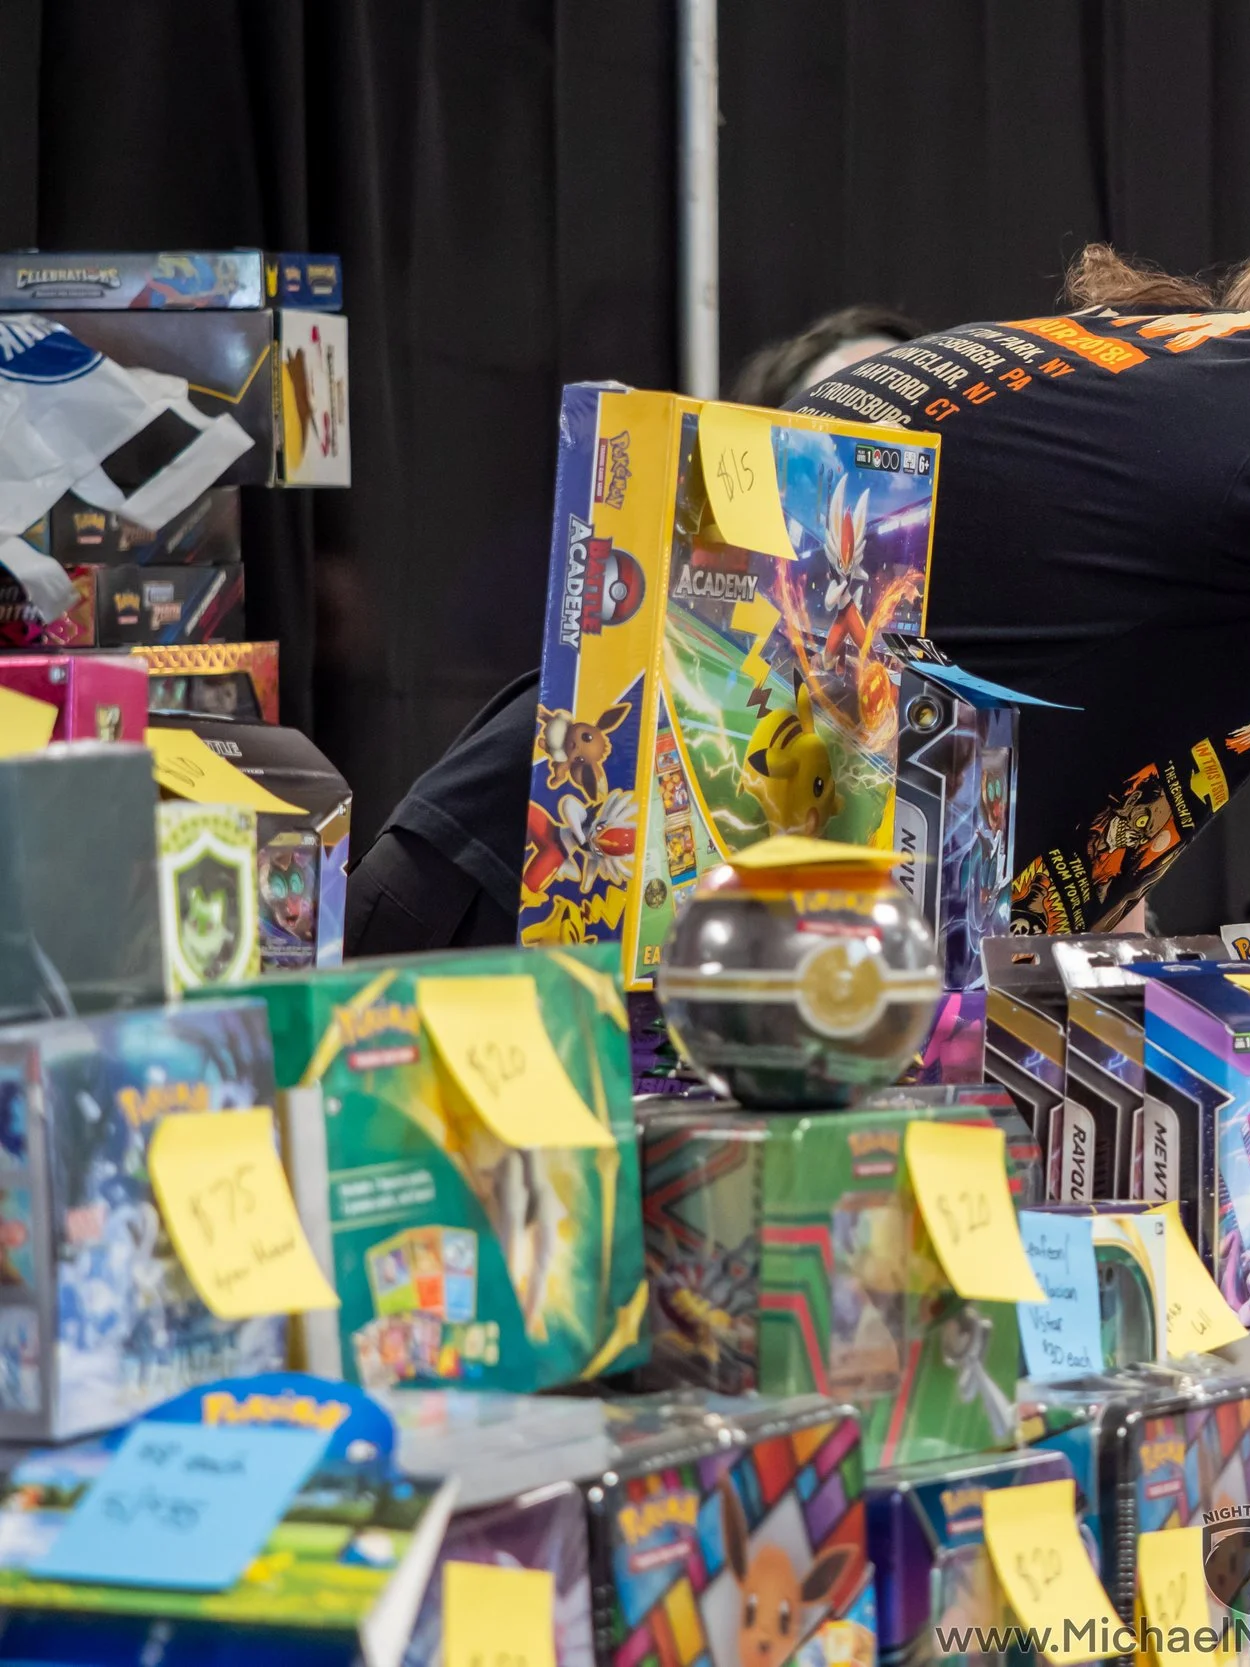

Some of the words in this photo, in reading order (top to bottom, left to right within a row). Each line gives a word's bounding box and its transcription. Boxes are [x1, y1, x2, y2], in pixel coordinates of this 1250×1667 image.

[1000, 333, 1045, 365] PARK,
[1037, 357, 1076, 379] NY
[1072, 334, 1134, 366] 2018!
[850, 361, 931, 407] HARTFORD,
[924, 397, 961, 423] CT
[962, 381, 997, 406] NJ
[998, 367, 1032, 393] PA
[716, 448, 755, 502] $15
[918, 455, 930, 474] 6+
[559, 513, 595, 649] ACADEMY
[581, 536, 613, 636] BATTLE
[672, 563, 760, 603] ACADEMY
[1194, 742, 1208, 758] IN
[1200, 756, 1220, 784] THIS
[1048, 848, 1069, 882] FROM
[1063, 881, 1080, 909] YOUR
[1070, 1124, 1087, 1200] RAYQU
[1154, 1120, 1168, 1200] MEWT
